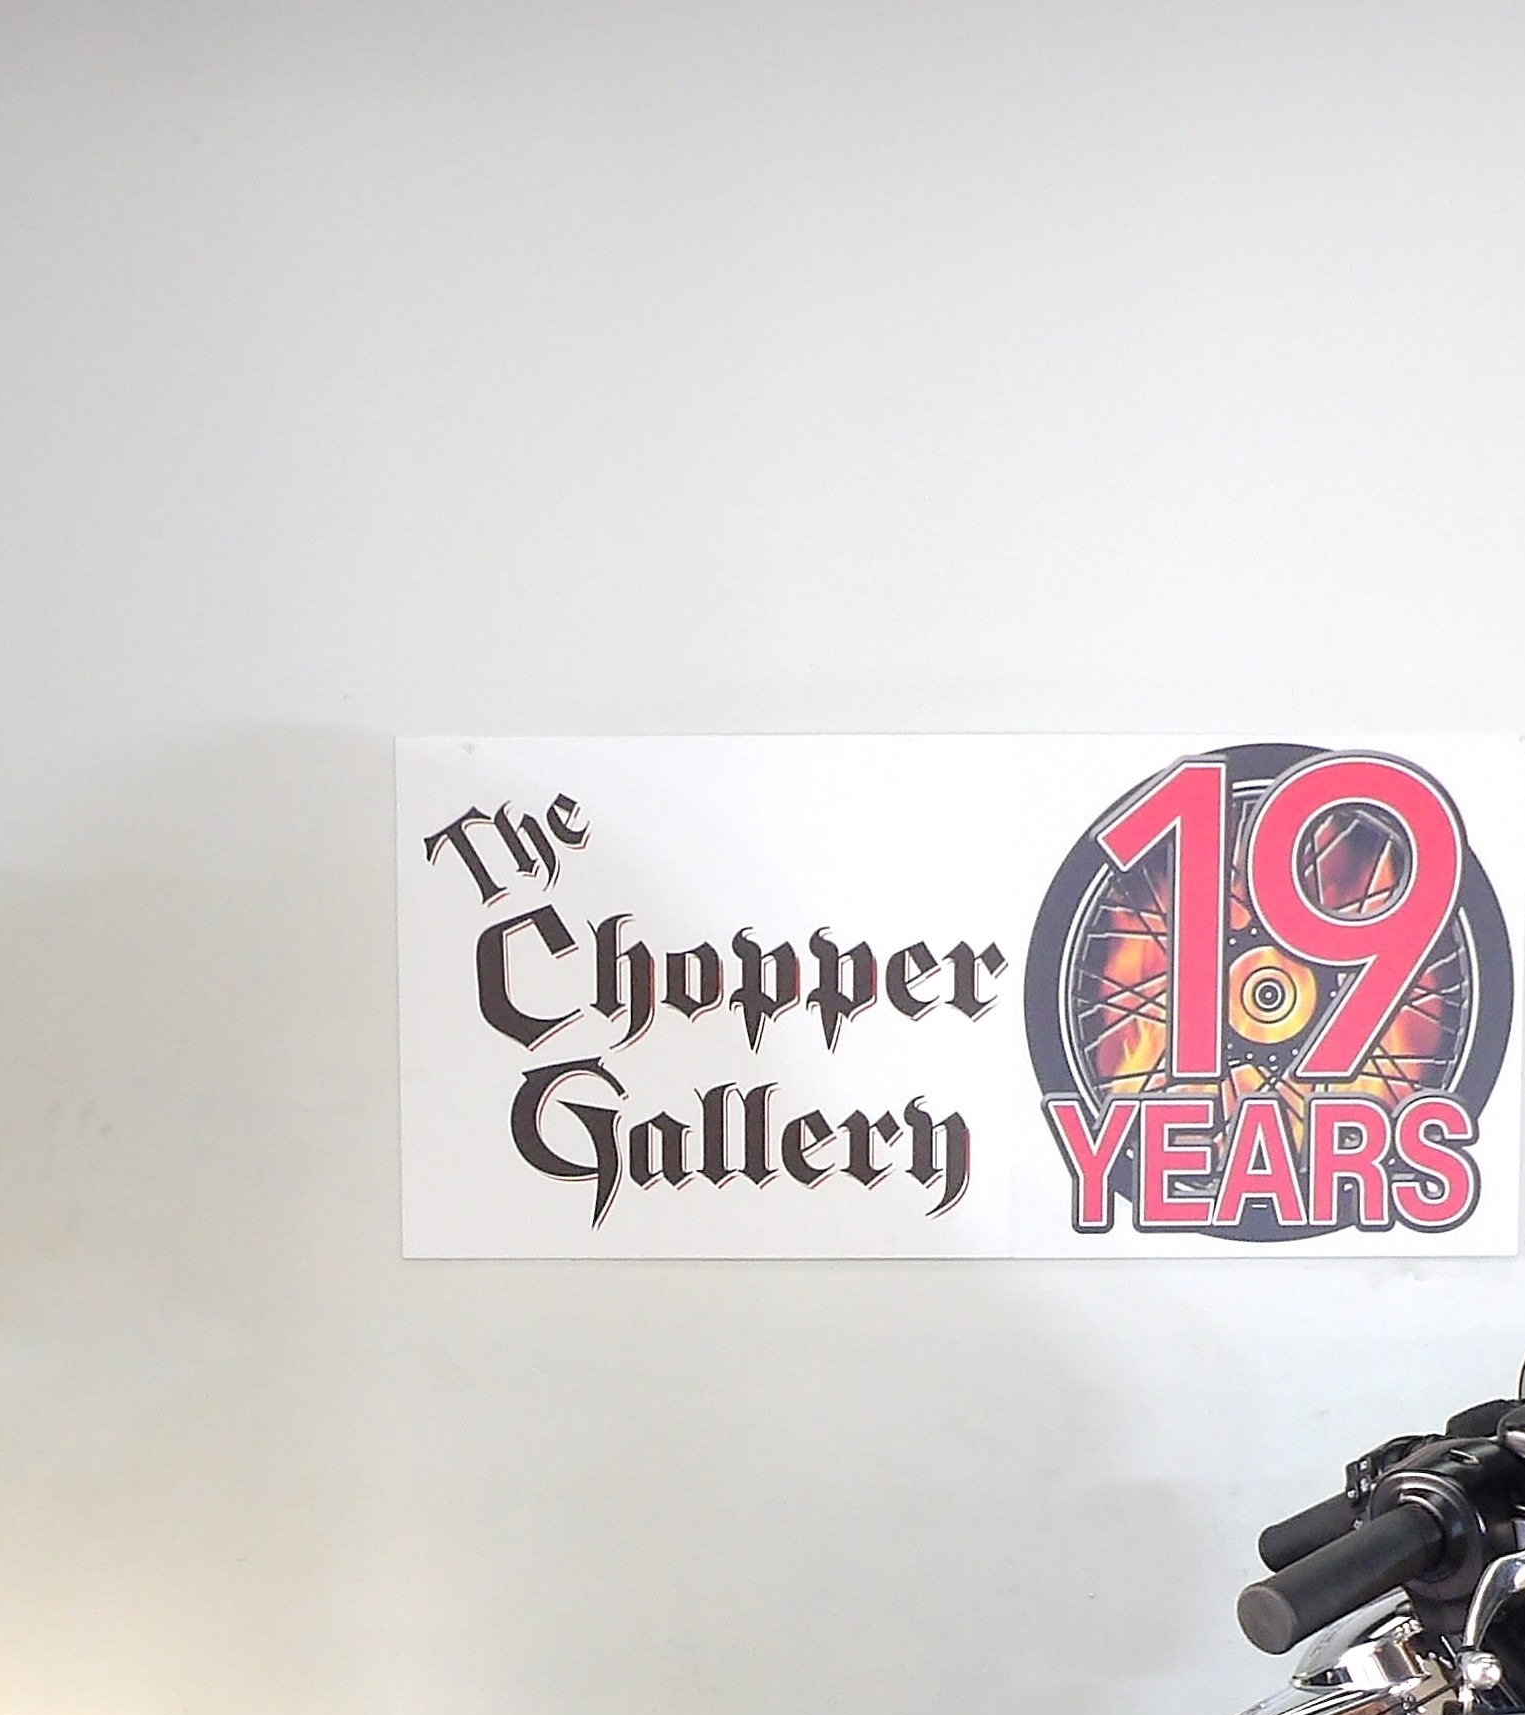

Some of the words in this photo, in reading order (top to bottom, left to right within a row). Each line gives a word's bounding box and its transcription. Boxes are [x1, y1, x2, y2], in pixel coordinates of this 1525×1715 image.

[424, 789, 594, 908] The
[1094, 752, 1468, 1082] 19
[474, 904, 1009, 1054] Chopper
[509, 1056, 970, 1231] Gallery
[1042, 1092, 1480, 1234] YEARS
